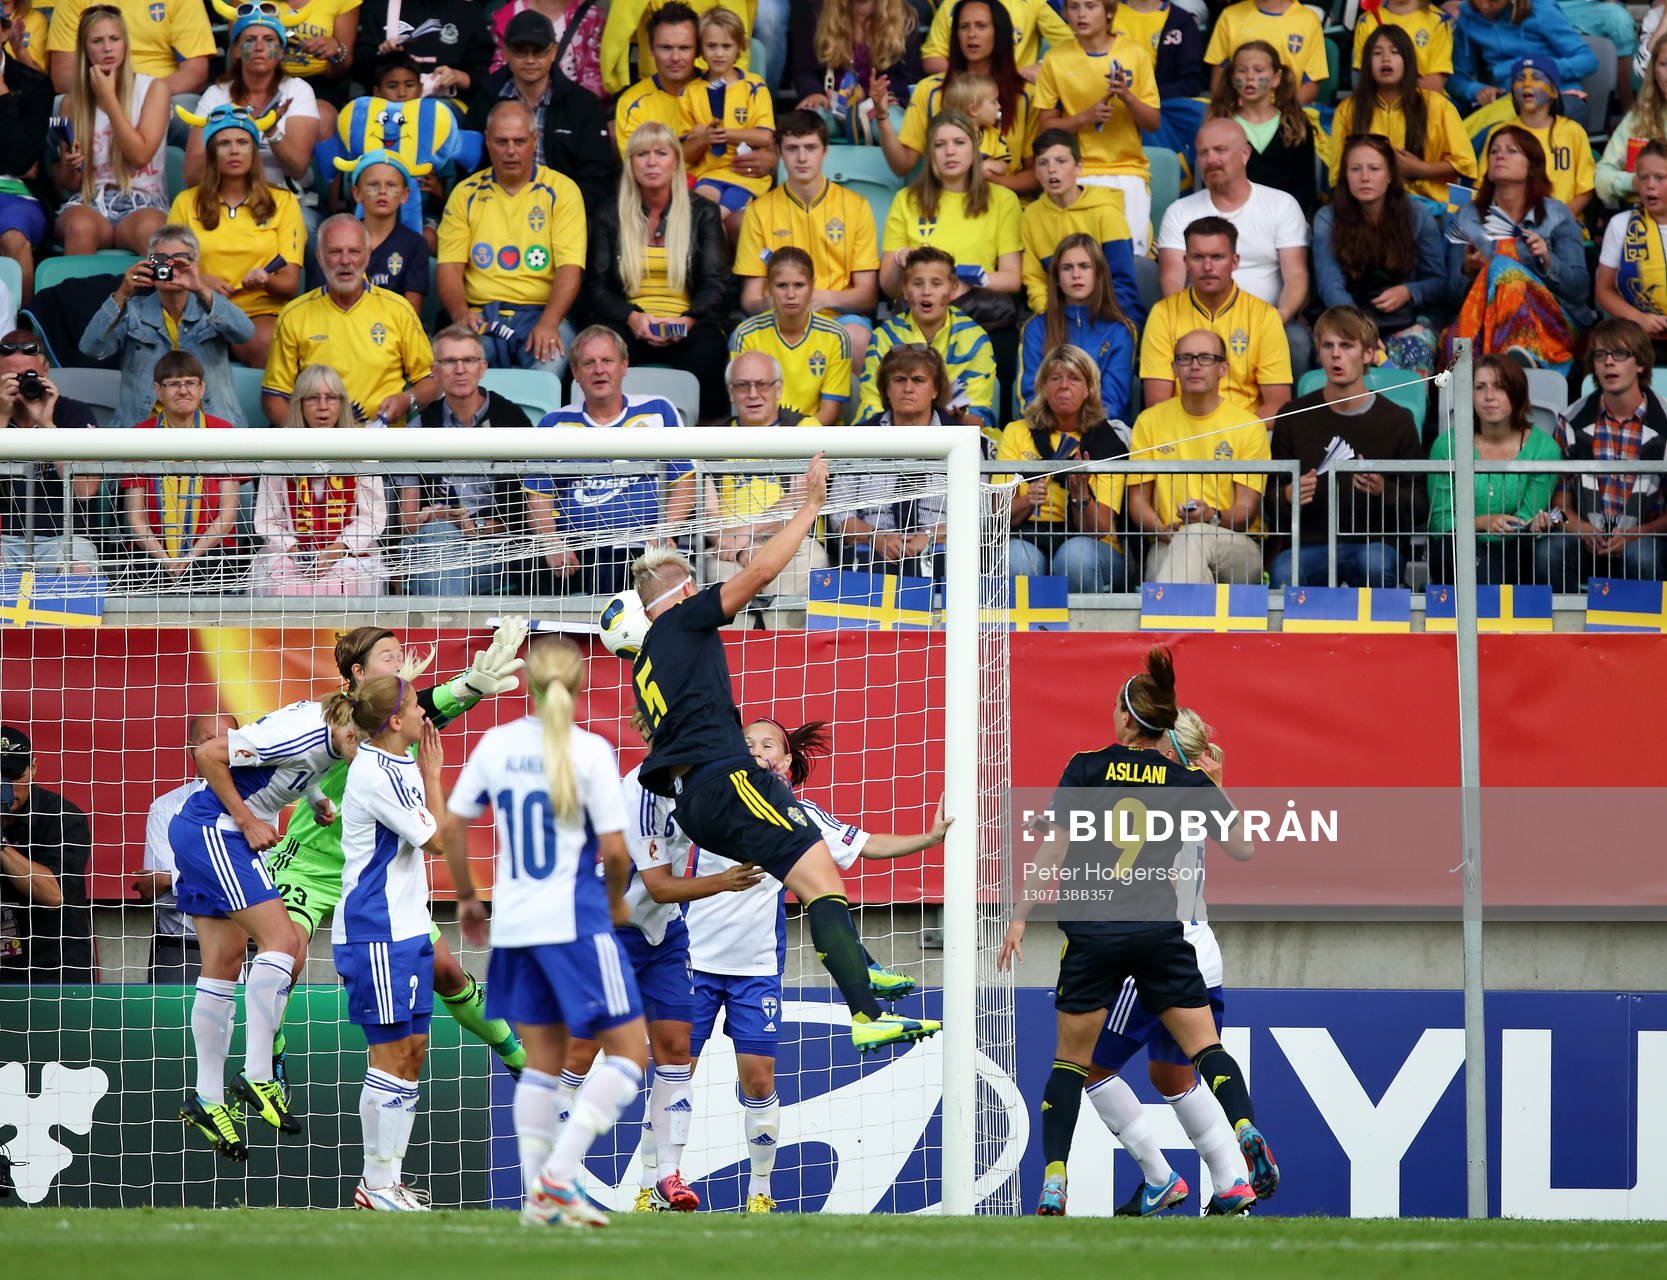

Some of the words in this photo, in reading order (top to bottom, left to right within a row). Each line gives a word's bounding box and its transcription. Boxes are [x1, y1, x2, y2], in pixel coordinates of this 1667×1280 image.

[1553, 146, 1571, 171] 10
[1105, 761, 1167, 785] ASLLANI
[496, 788, 557, 881] 10
[1111, 797, 1148, 879] 9
[409, 974, 419, 1010] 3
